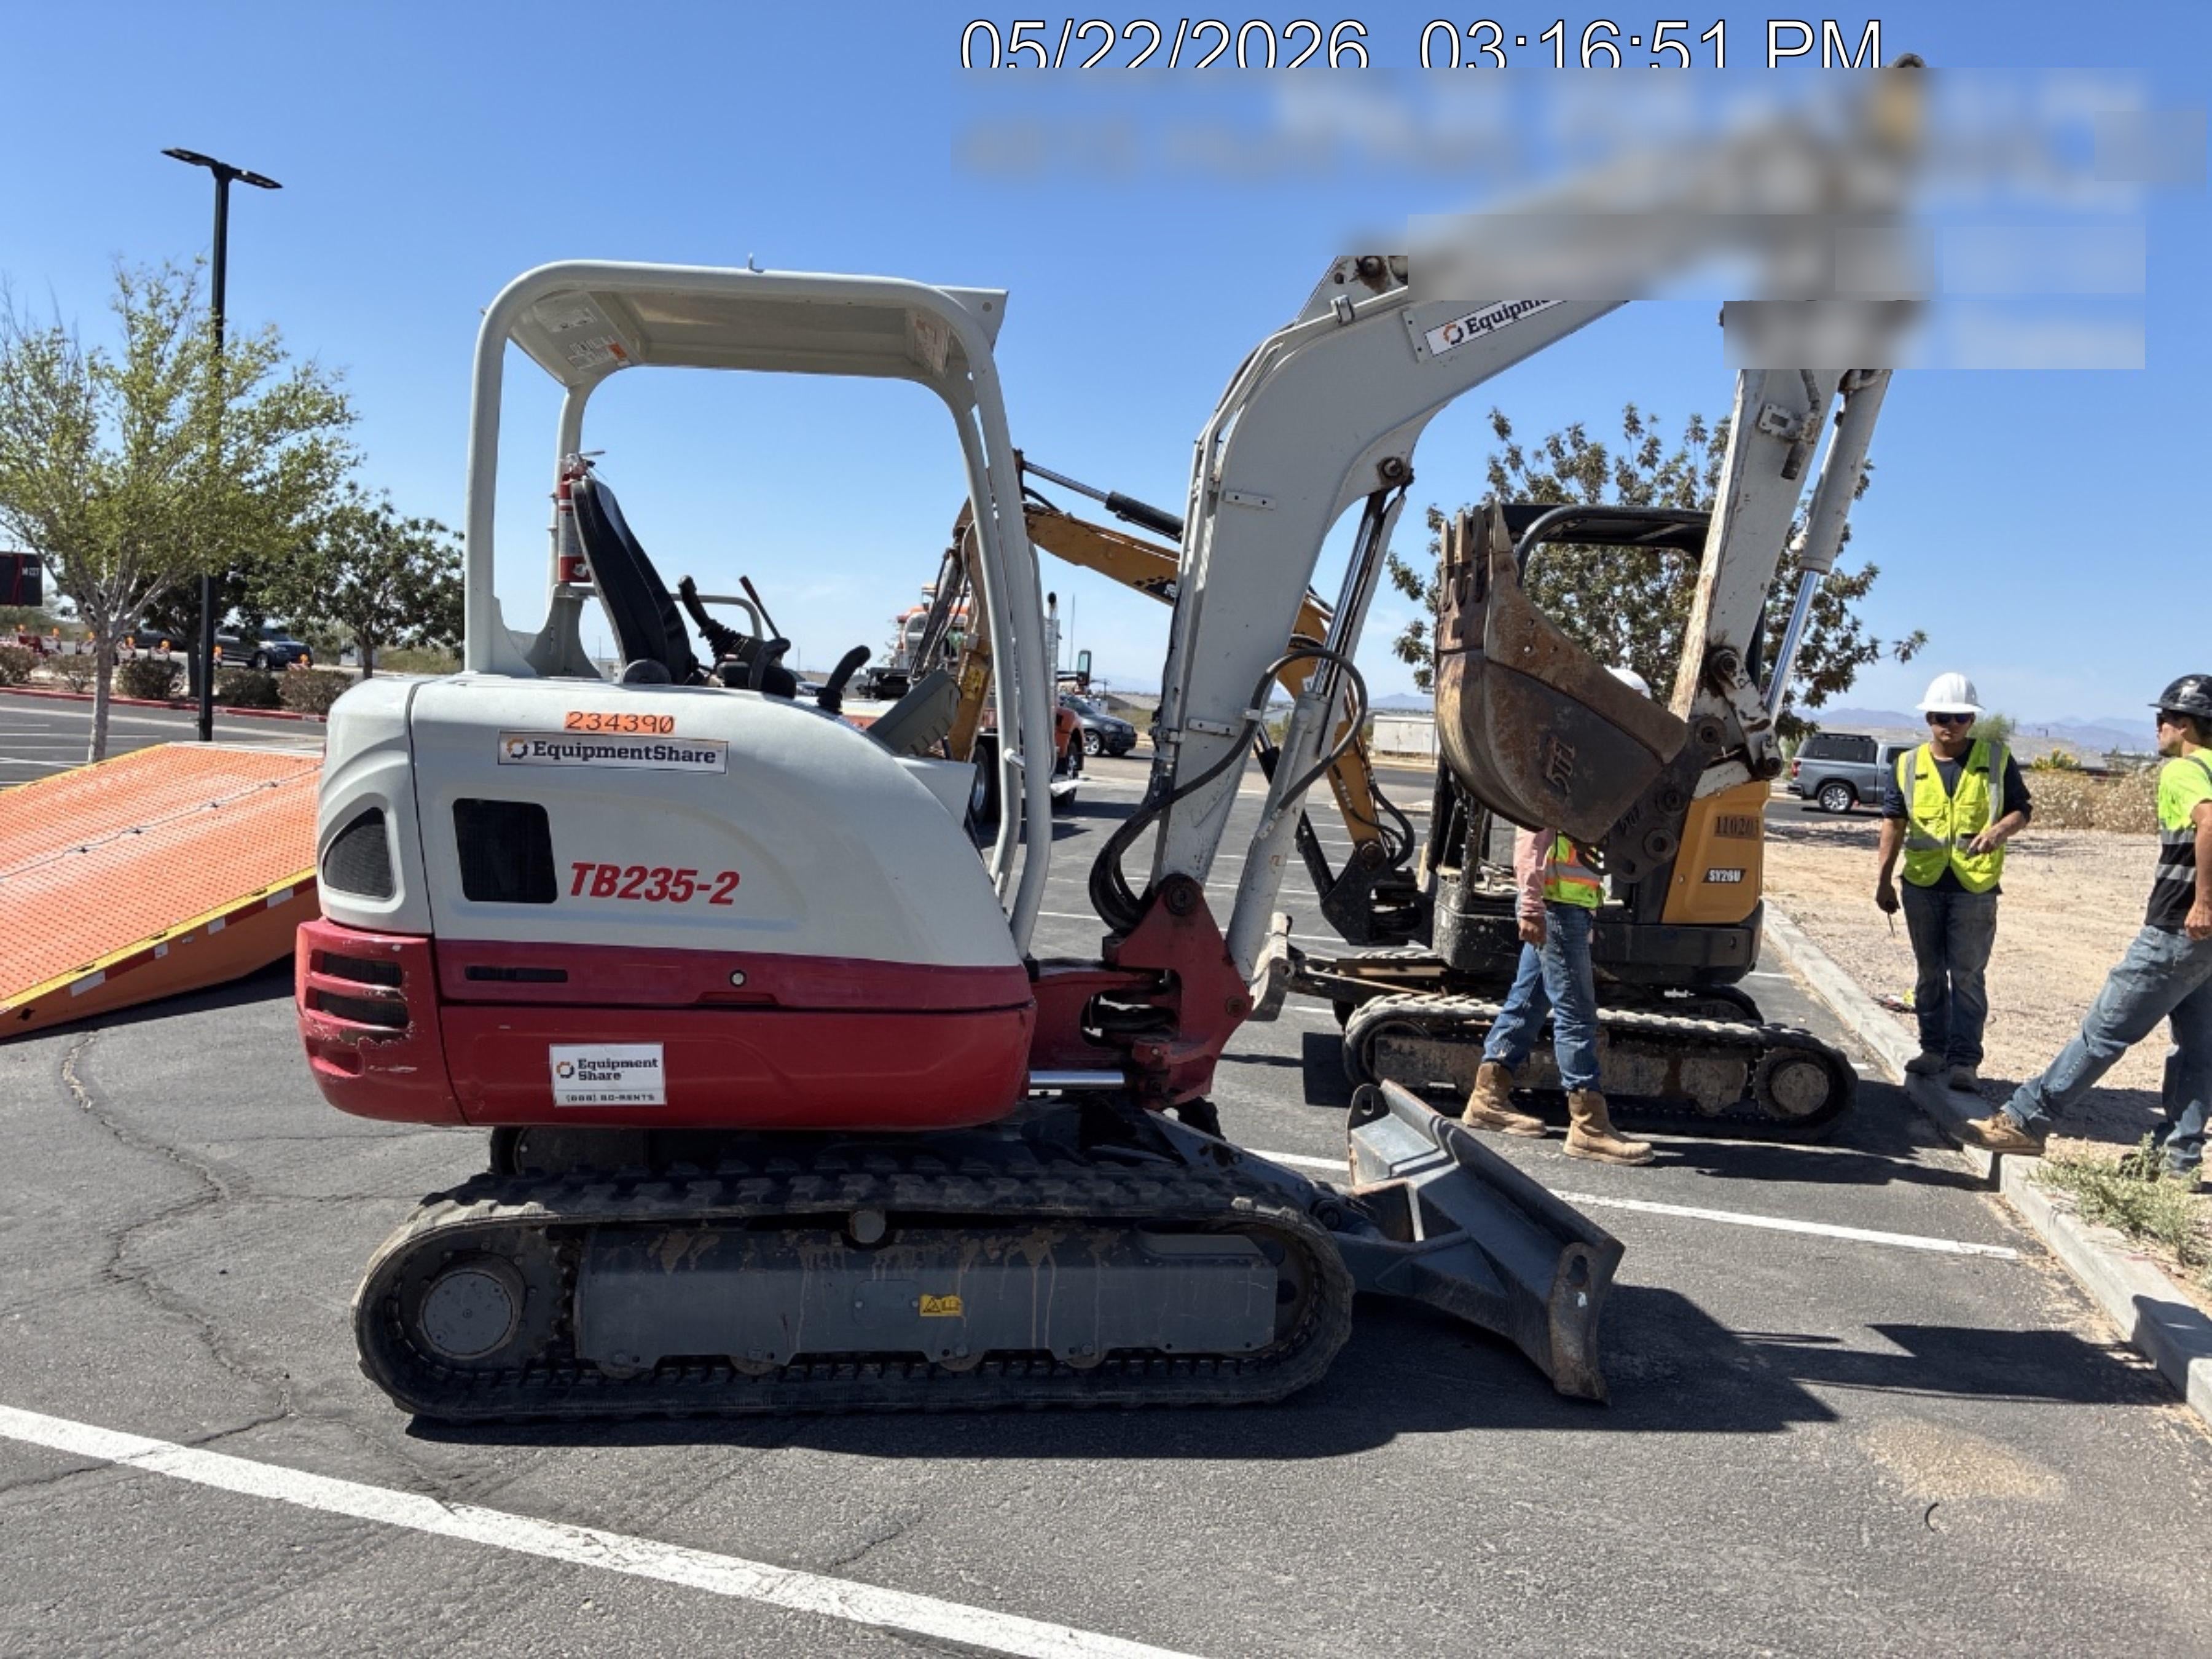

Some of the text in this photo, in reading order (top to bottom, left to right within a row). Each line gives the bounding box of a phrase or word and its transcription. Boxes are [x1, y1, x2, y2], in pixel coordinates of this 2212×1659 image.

[565, 710, 675, 734] 234390
[532, 740, 717, 764] EquipmentShare
[570, 862, 740, 906] TB235-2
[578, 1058, 658, 1071] Equipment
[578, 1070, 622, 1081] Share
